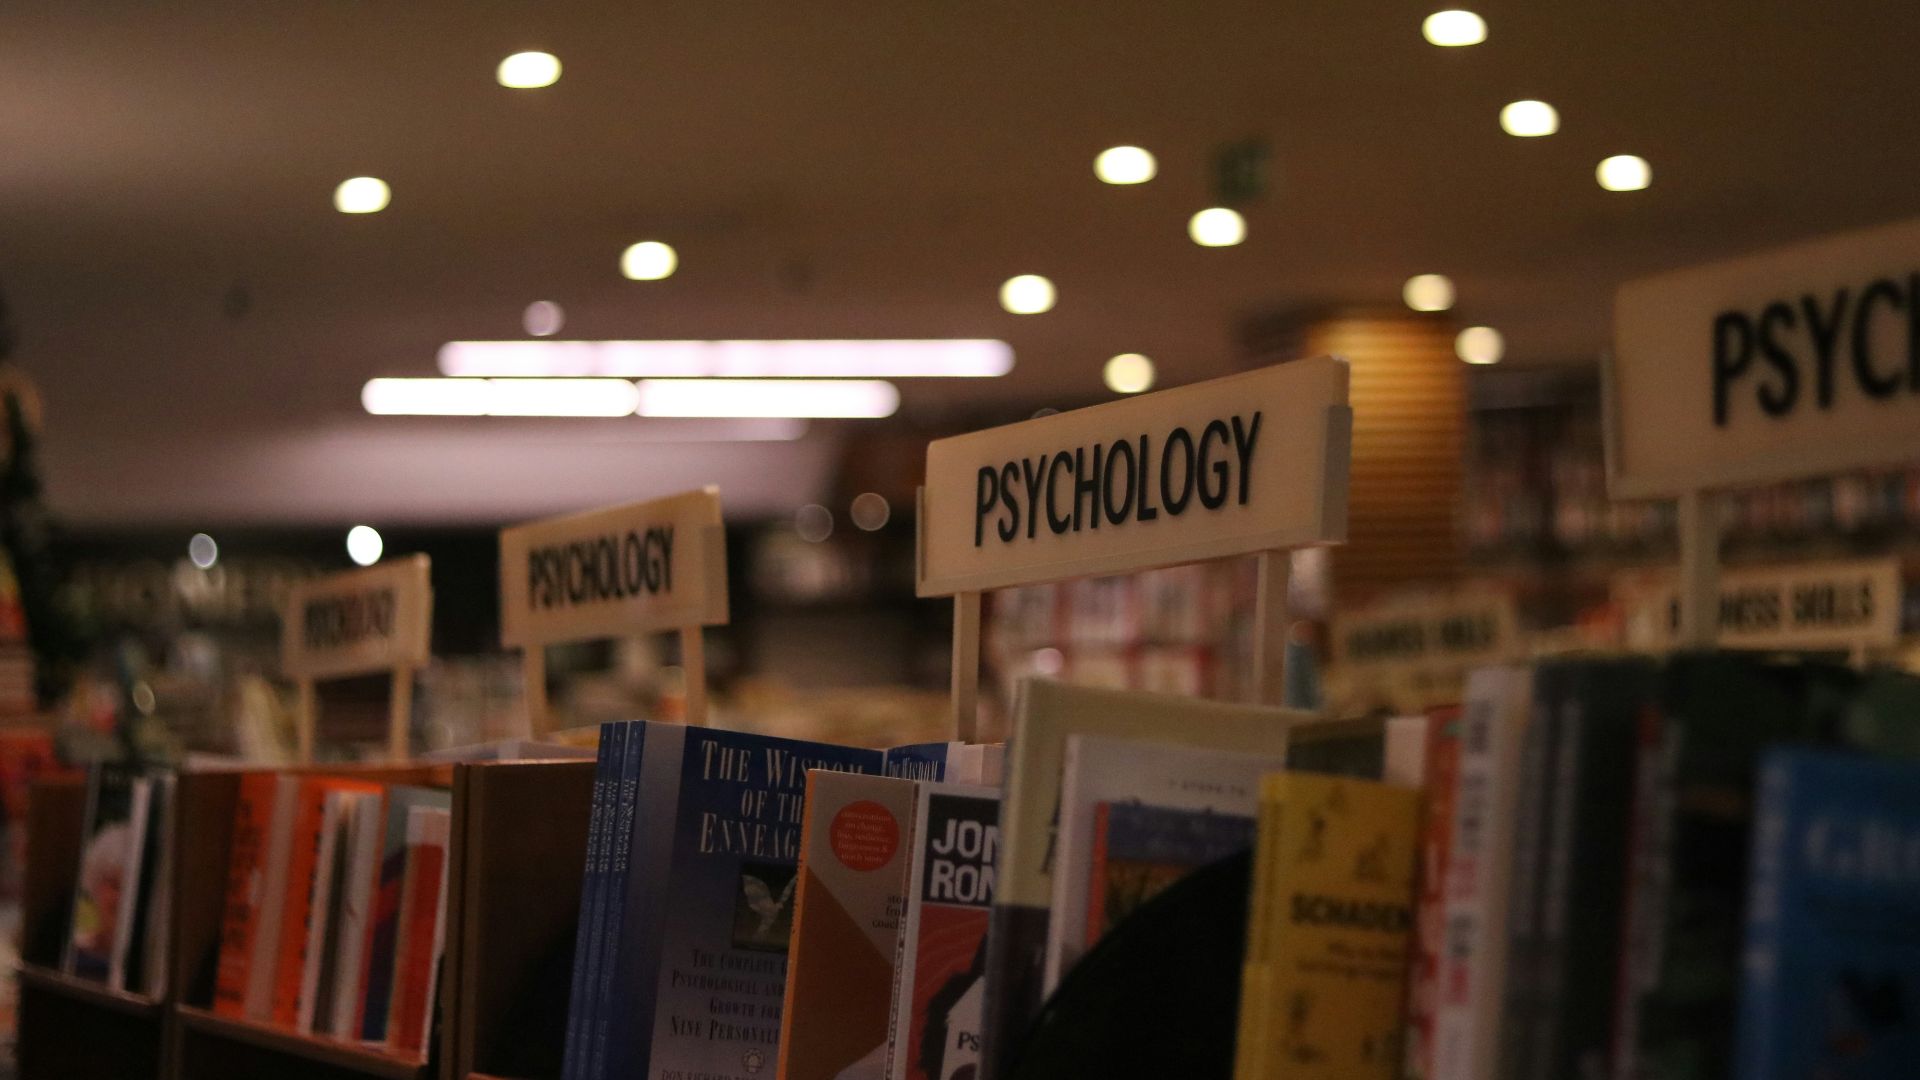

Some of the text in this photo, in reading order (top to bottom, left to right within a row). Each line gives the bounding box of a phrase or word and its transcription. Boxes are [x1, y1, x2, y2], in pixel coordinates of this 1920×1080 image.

[975, 411, 1262, 547] PSYCHOLOGY
[528, 525, 675, 610] PSYCHOLOGY
[702, 740, 863, 789] THE WIS
[740, 789, 769, 819] OF
[700, 812, 798, 859] ENNEAG
[932, 818, 998, 863] JON
[929, 859, 994, 902] RON
[693, 949, 715, 968] THE
[672, 968, 760, 995] PSYCHOLOGICAL
[670, 1015, 703, 1037] NINE
[709, 997, 756, 1017] GROWTH
